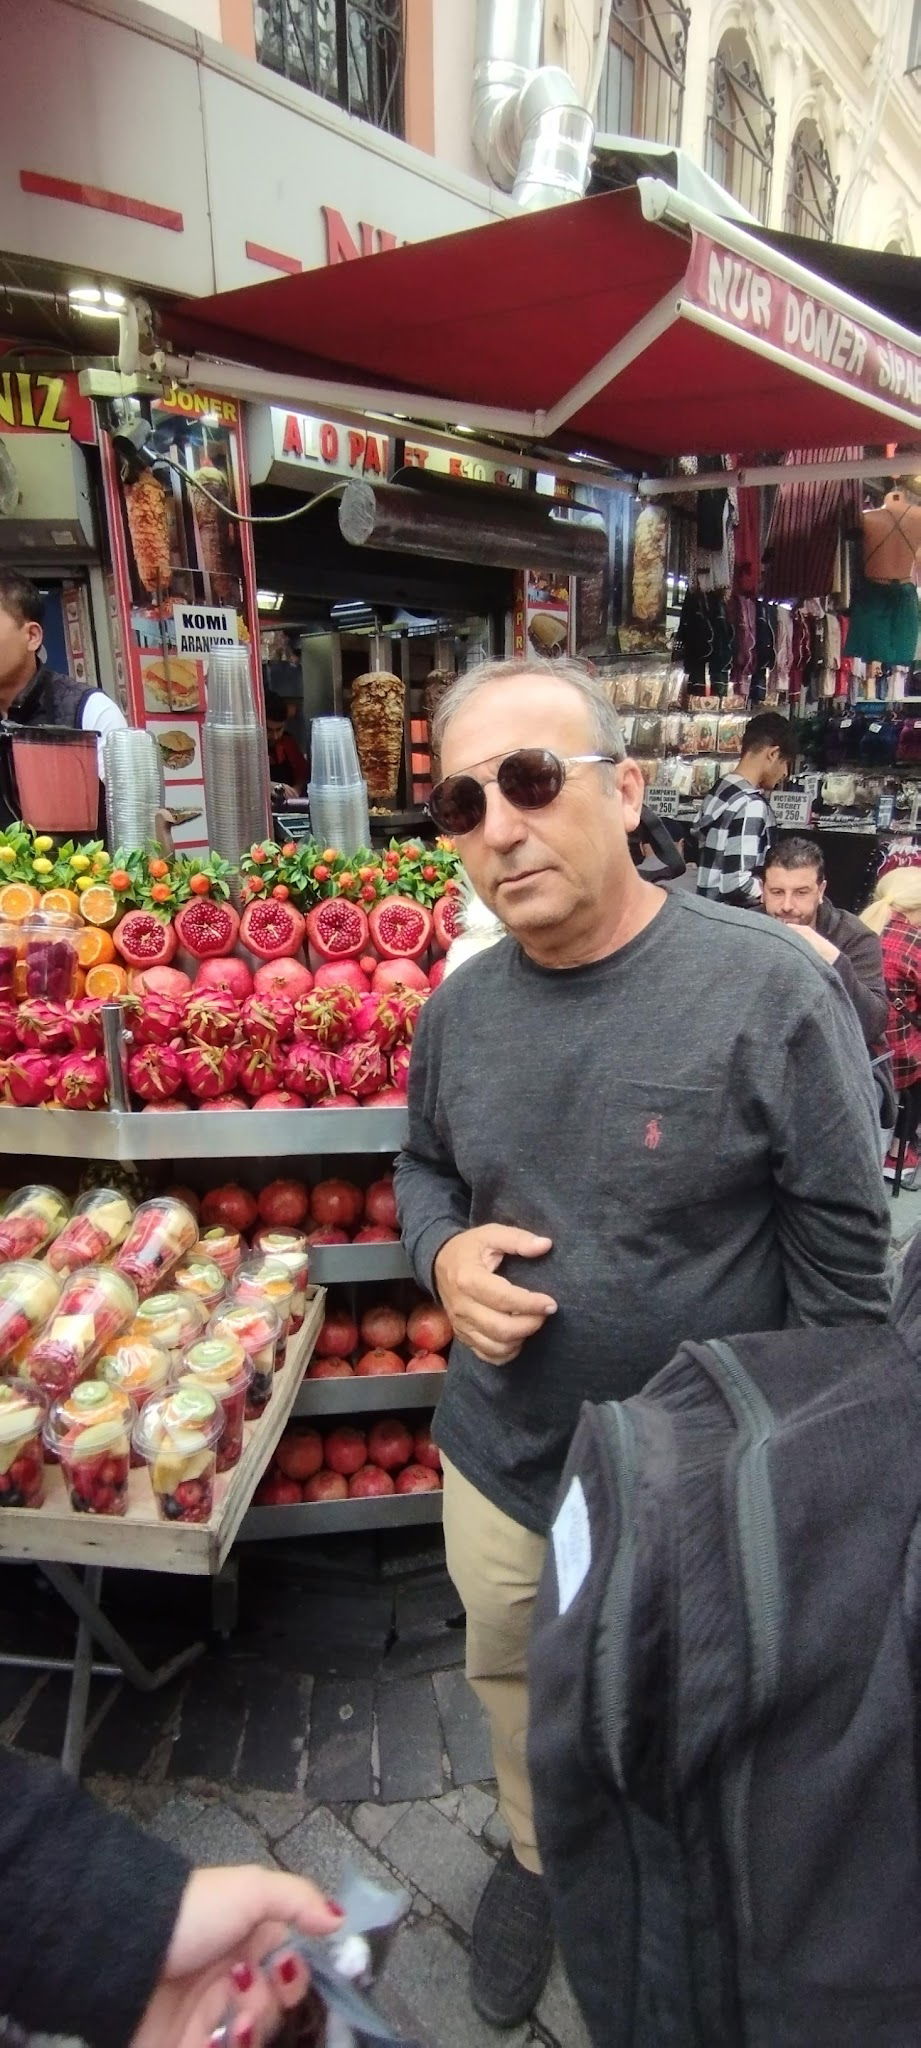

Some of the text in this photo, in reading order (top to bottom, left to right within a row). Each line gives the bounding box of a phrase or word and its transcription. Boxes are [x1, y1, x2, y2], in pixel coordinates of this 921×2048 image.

[708, 250, 772, 330] NUR
[783, 291, 868, 376] DÖNER
[282, 415, 339, 463] ALO
[348, 431, 429, 477] PAT
[182, 614, 228, 631] KOMİ
[659, 802, 672, 813] 250
[776, 802, 801, 810] SECRET
[784, 810, 800, 821] 250
